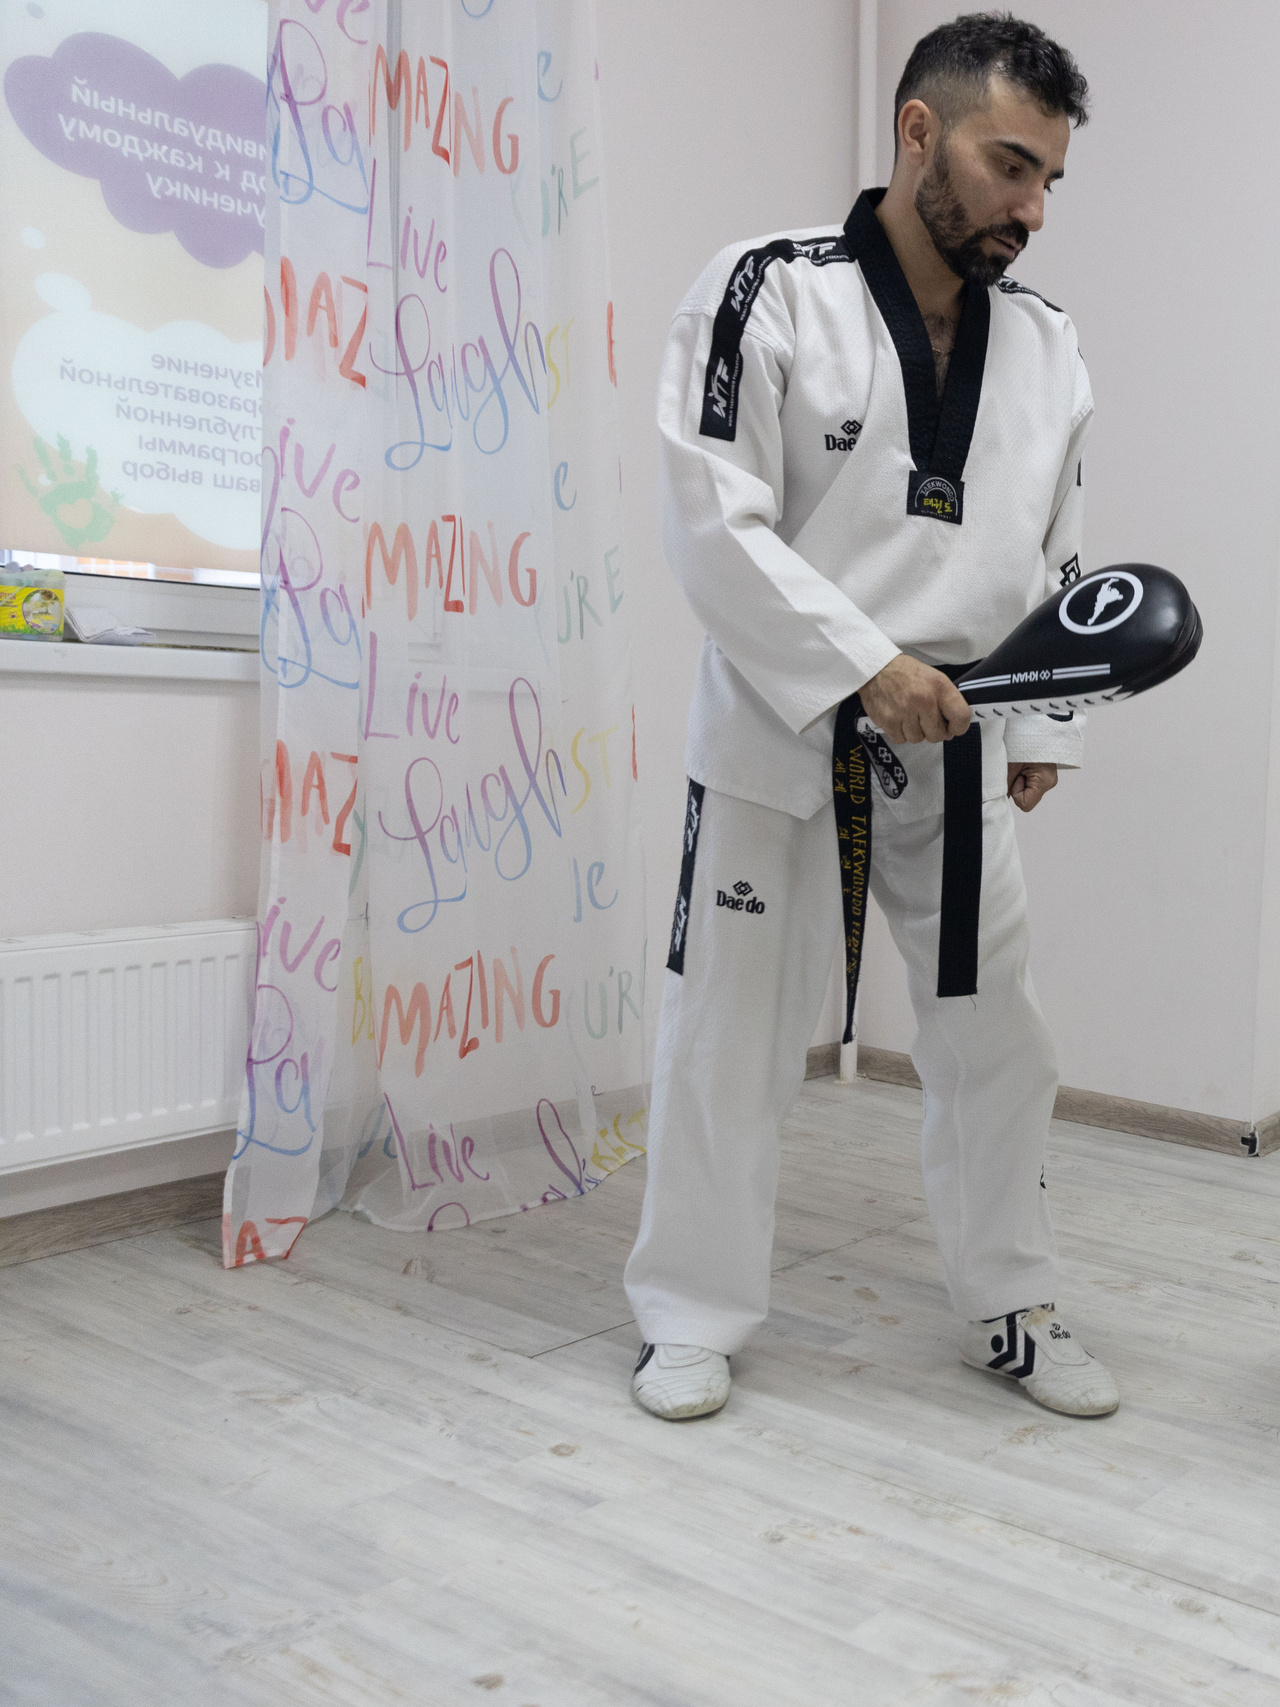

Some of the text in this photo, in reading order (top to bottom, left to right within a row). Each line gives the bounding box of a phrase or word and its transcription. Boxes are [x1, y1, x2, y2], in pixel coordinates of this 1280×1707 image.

[920, 481, 955, 502] TAEKWONDO
[364, 631, 460, 744] Live
[1012, 670, 1039, 684] KHAN
[849, 744, 866, 804] WORLD
[851, 815, 867, 916] TAEKWONDO
